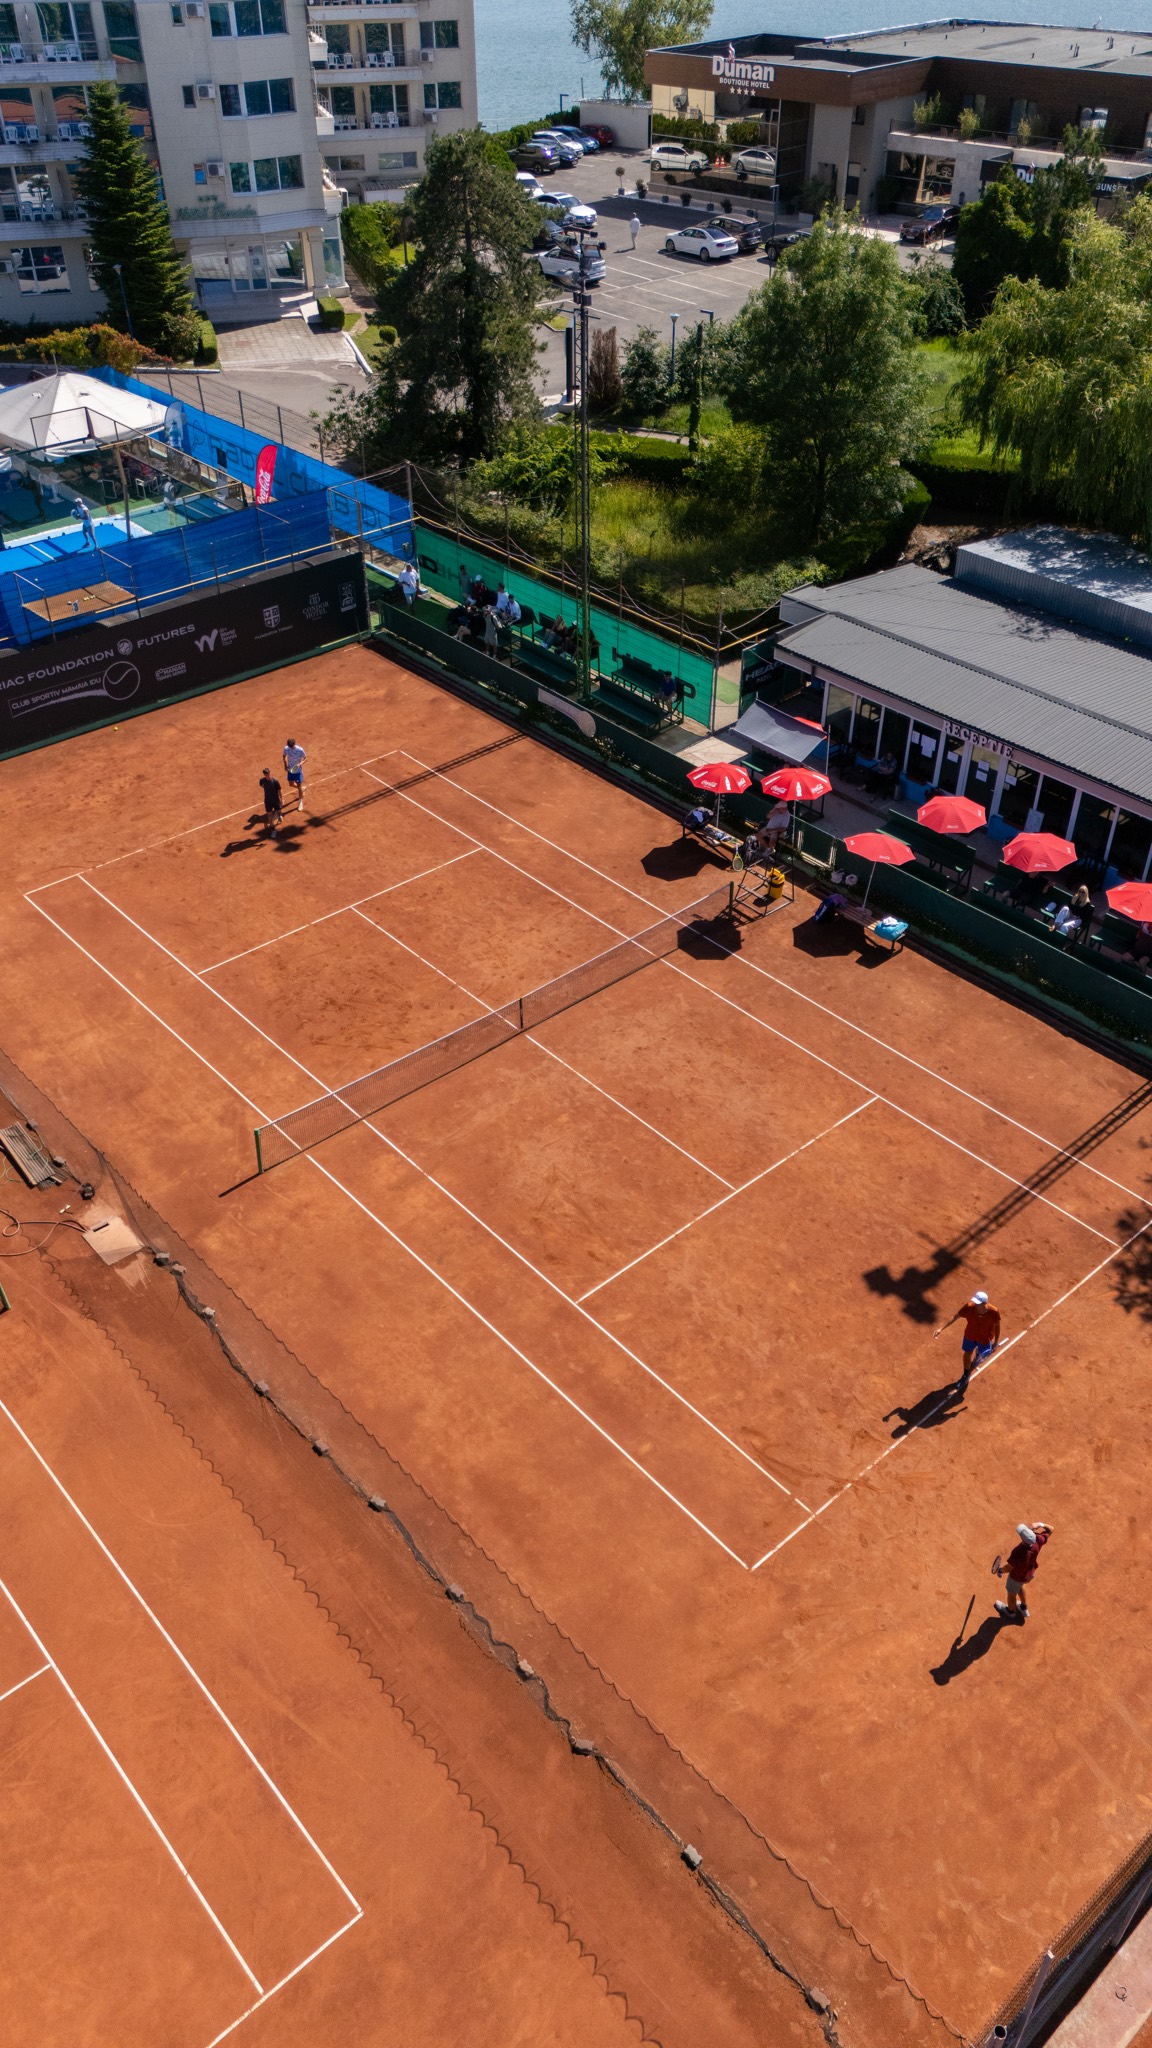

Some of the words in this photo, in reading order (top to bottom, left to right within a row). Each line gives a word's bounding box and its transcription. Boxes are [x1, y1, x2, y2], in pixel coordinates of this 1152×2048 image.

[712, 55, 775, 82] Duman
[719, 77, 751, 87] BOUTIQUE
[28, 648, 115, 682] FOUNDATION
[136, 624, 196, 649] FUTURES
[12, 699, 31, 710] CLUB
[31, 690, 61, 704] SPORTIV
[61, 681, 89, 695] MAMAIA
[89, 677, 102, 686] IDU
[942, 719, 1014, 759] RECEPTIE
